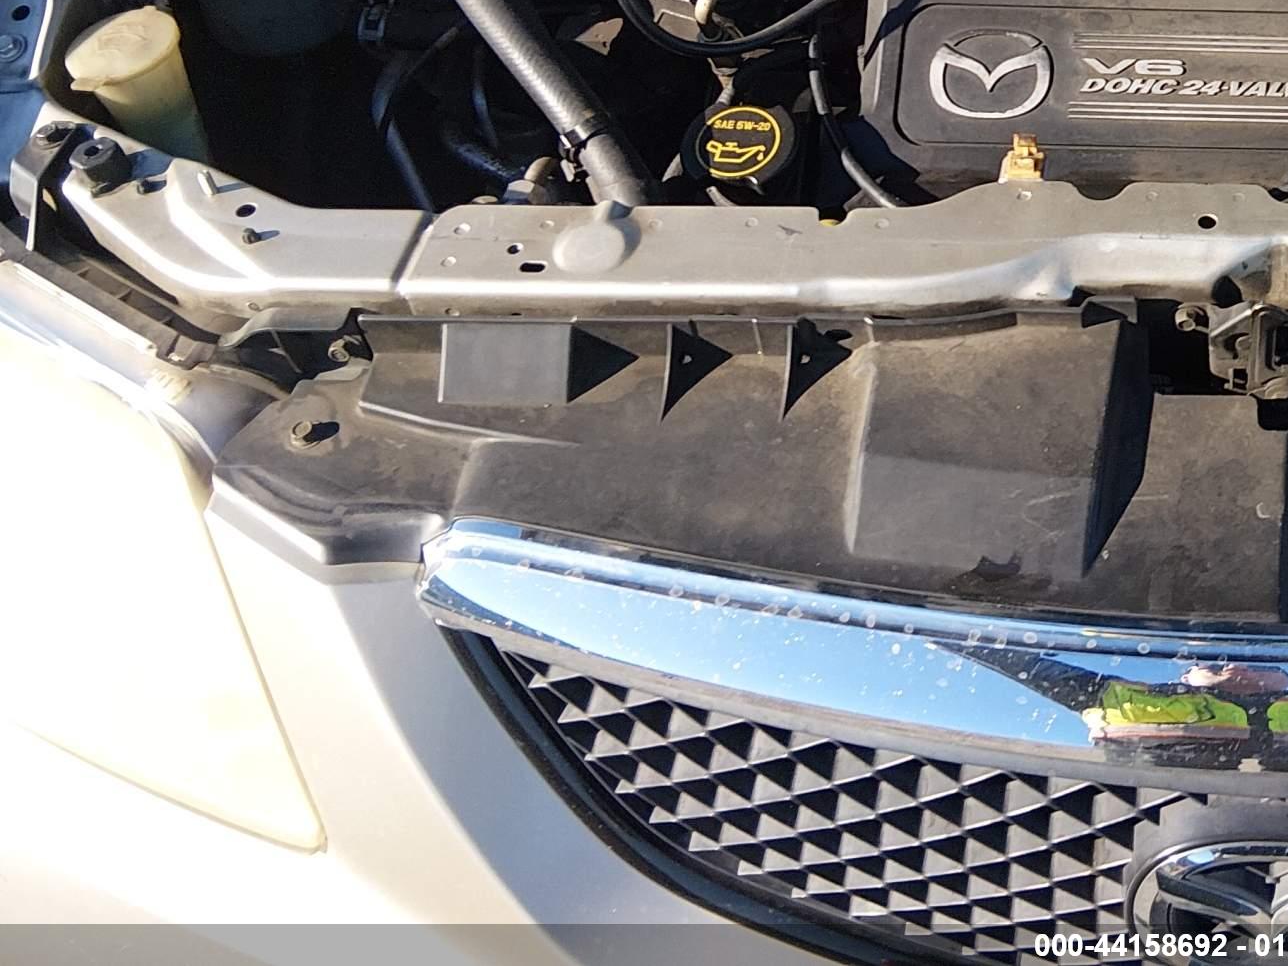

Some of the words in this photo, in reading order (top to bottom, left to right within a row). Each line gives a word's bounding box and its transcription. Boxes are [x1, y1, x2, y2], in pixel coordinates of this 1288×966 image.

[1082, 57, 1186, 76] V6
[1079, 77, 1179, 95] DOHC
[713, 119, 736, 130] SAE
